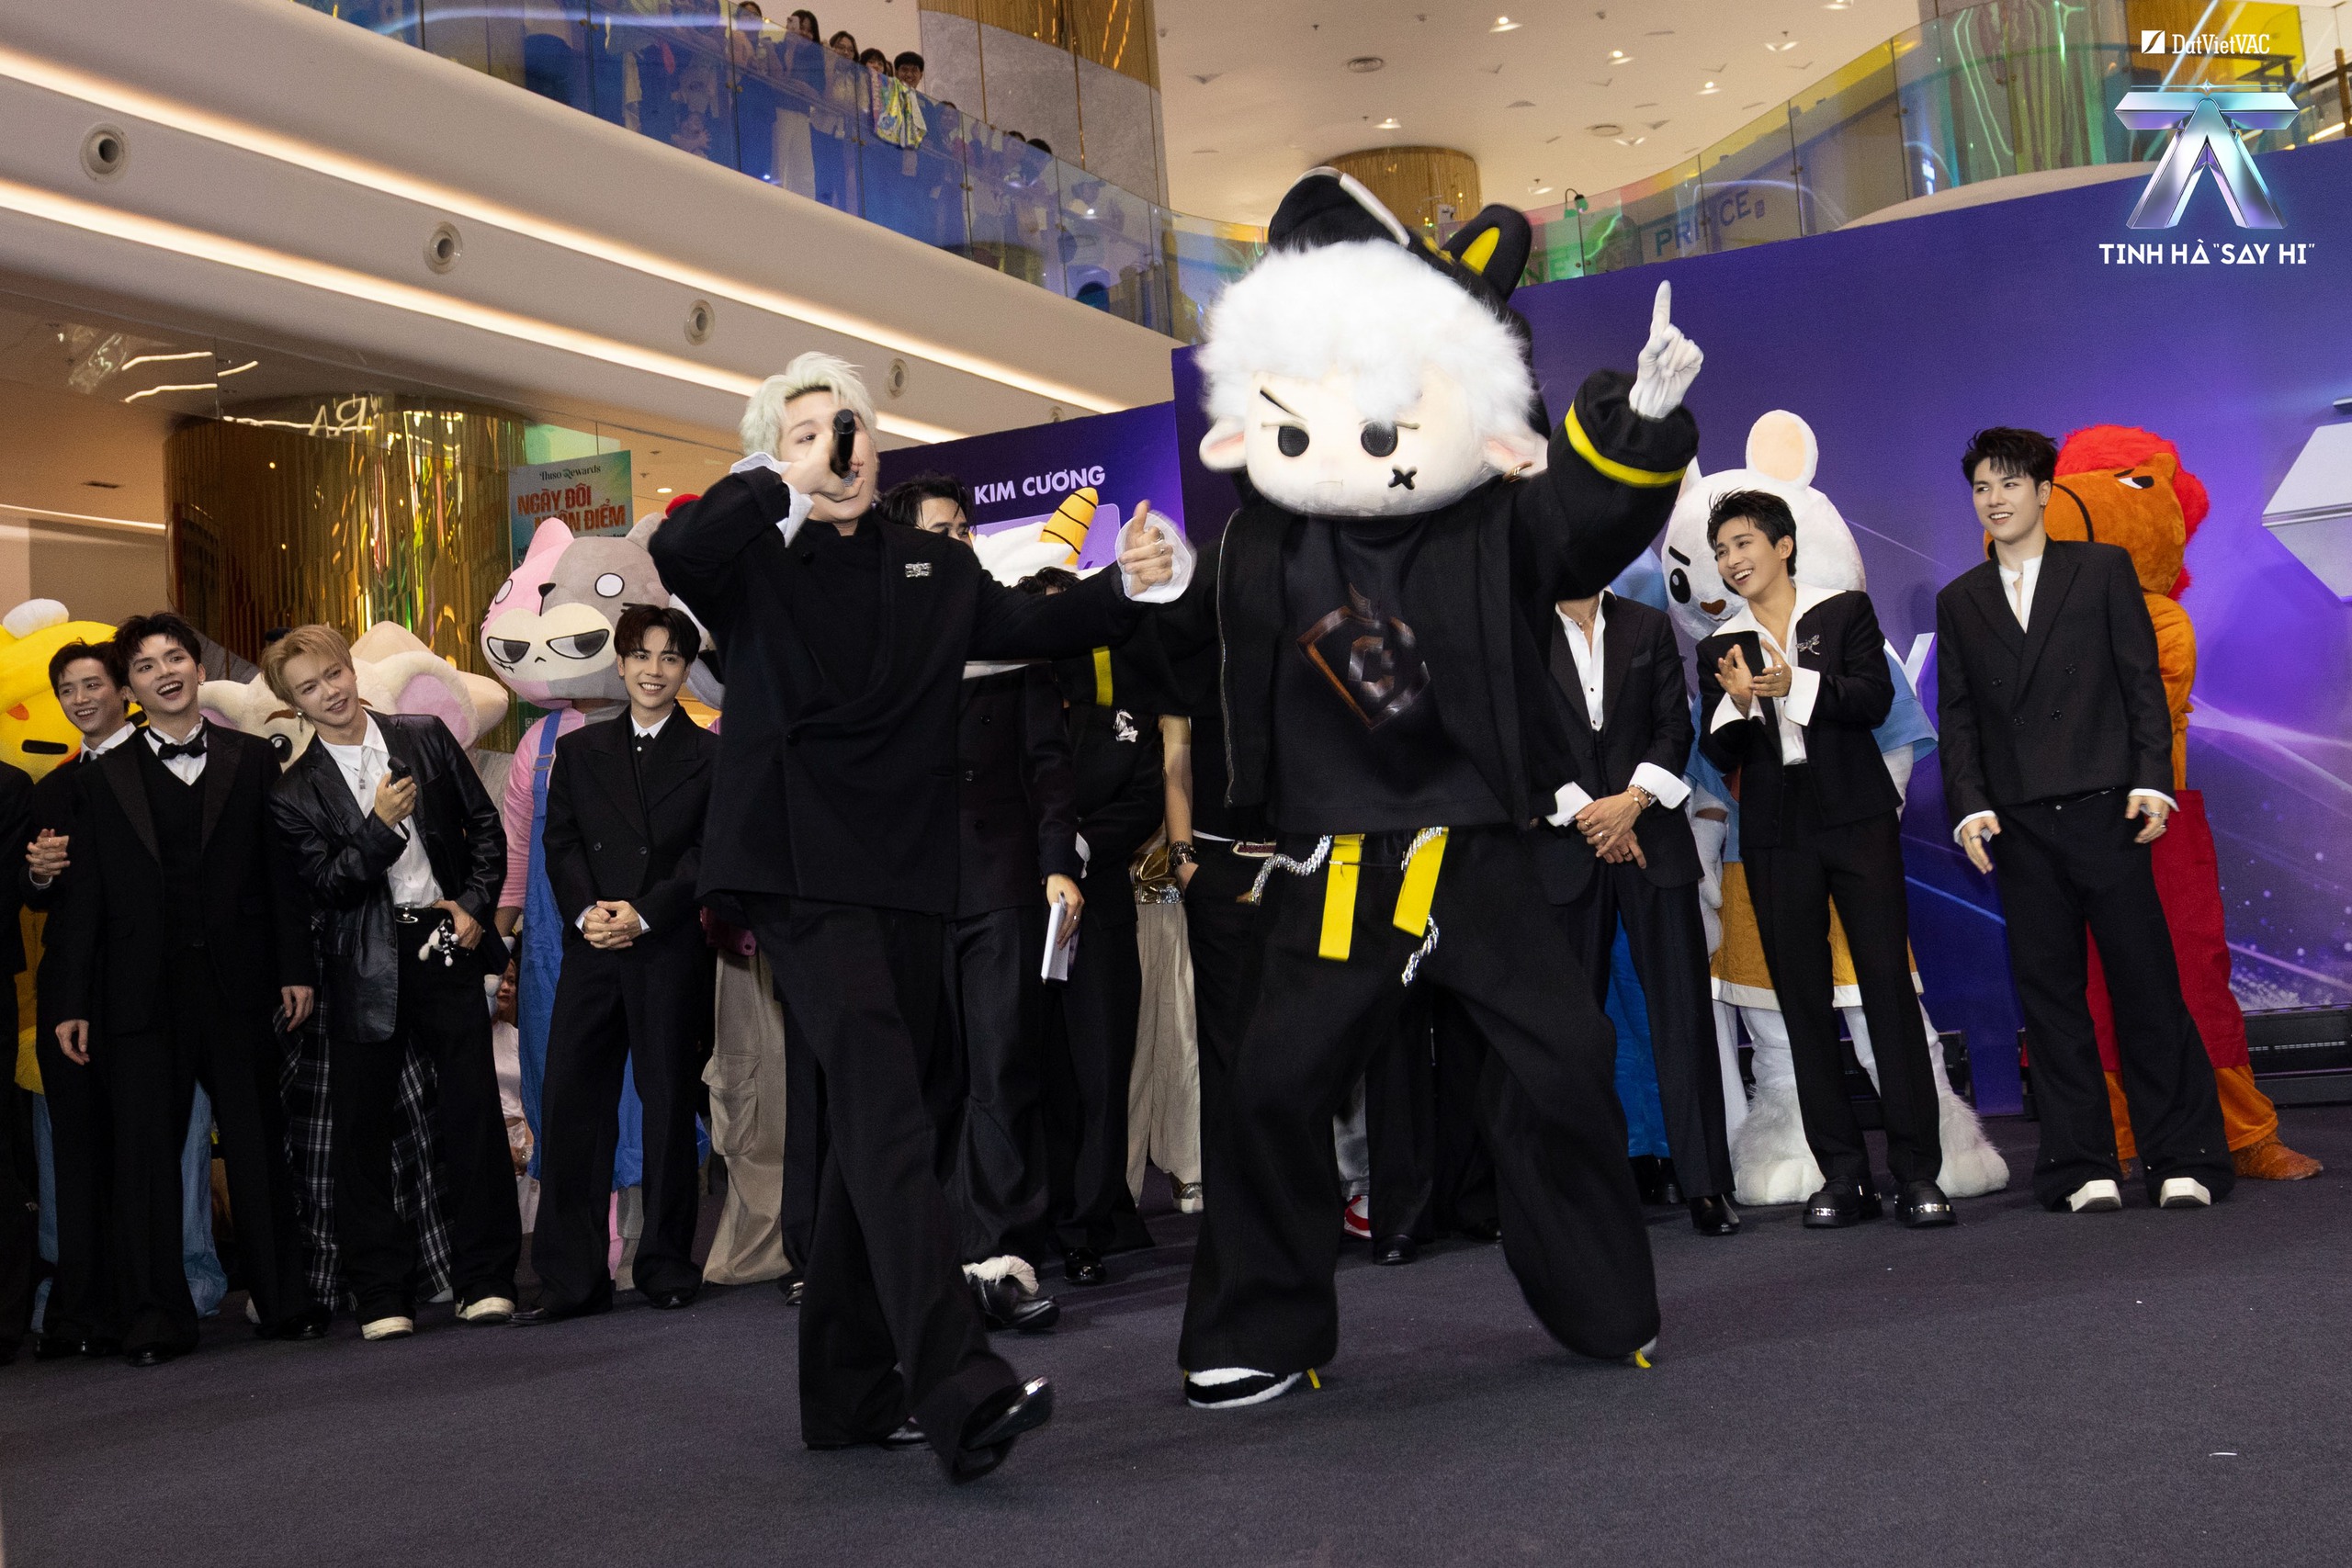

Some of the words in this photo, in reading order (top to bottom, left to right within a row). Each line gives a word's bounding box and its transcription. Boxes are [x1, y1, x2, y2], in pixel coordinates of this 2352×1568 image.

[1655, 190, 1751, 257] PRICE
[562, 464, 601, 479] Rewards
[974, 479, 1016, 505] KIM
[1022, 465, 1105, 497] CƯƠNG
[516, 488, 561, 515] NGÀY
